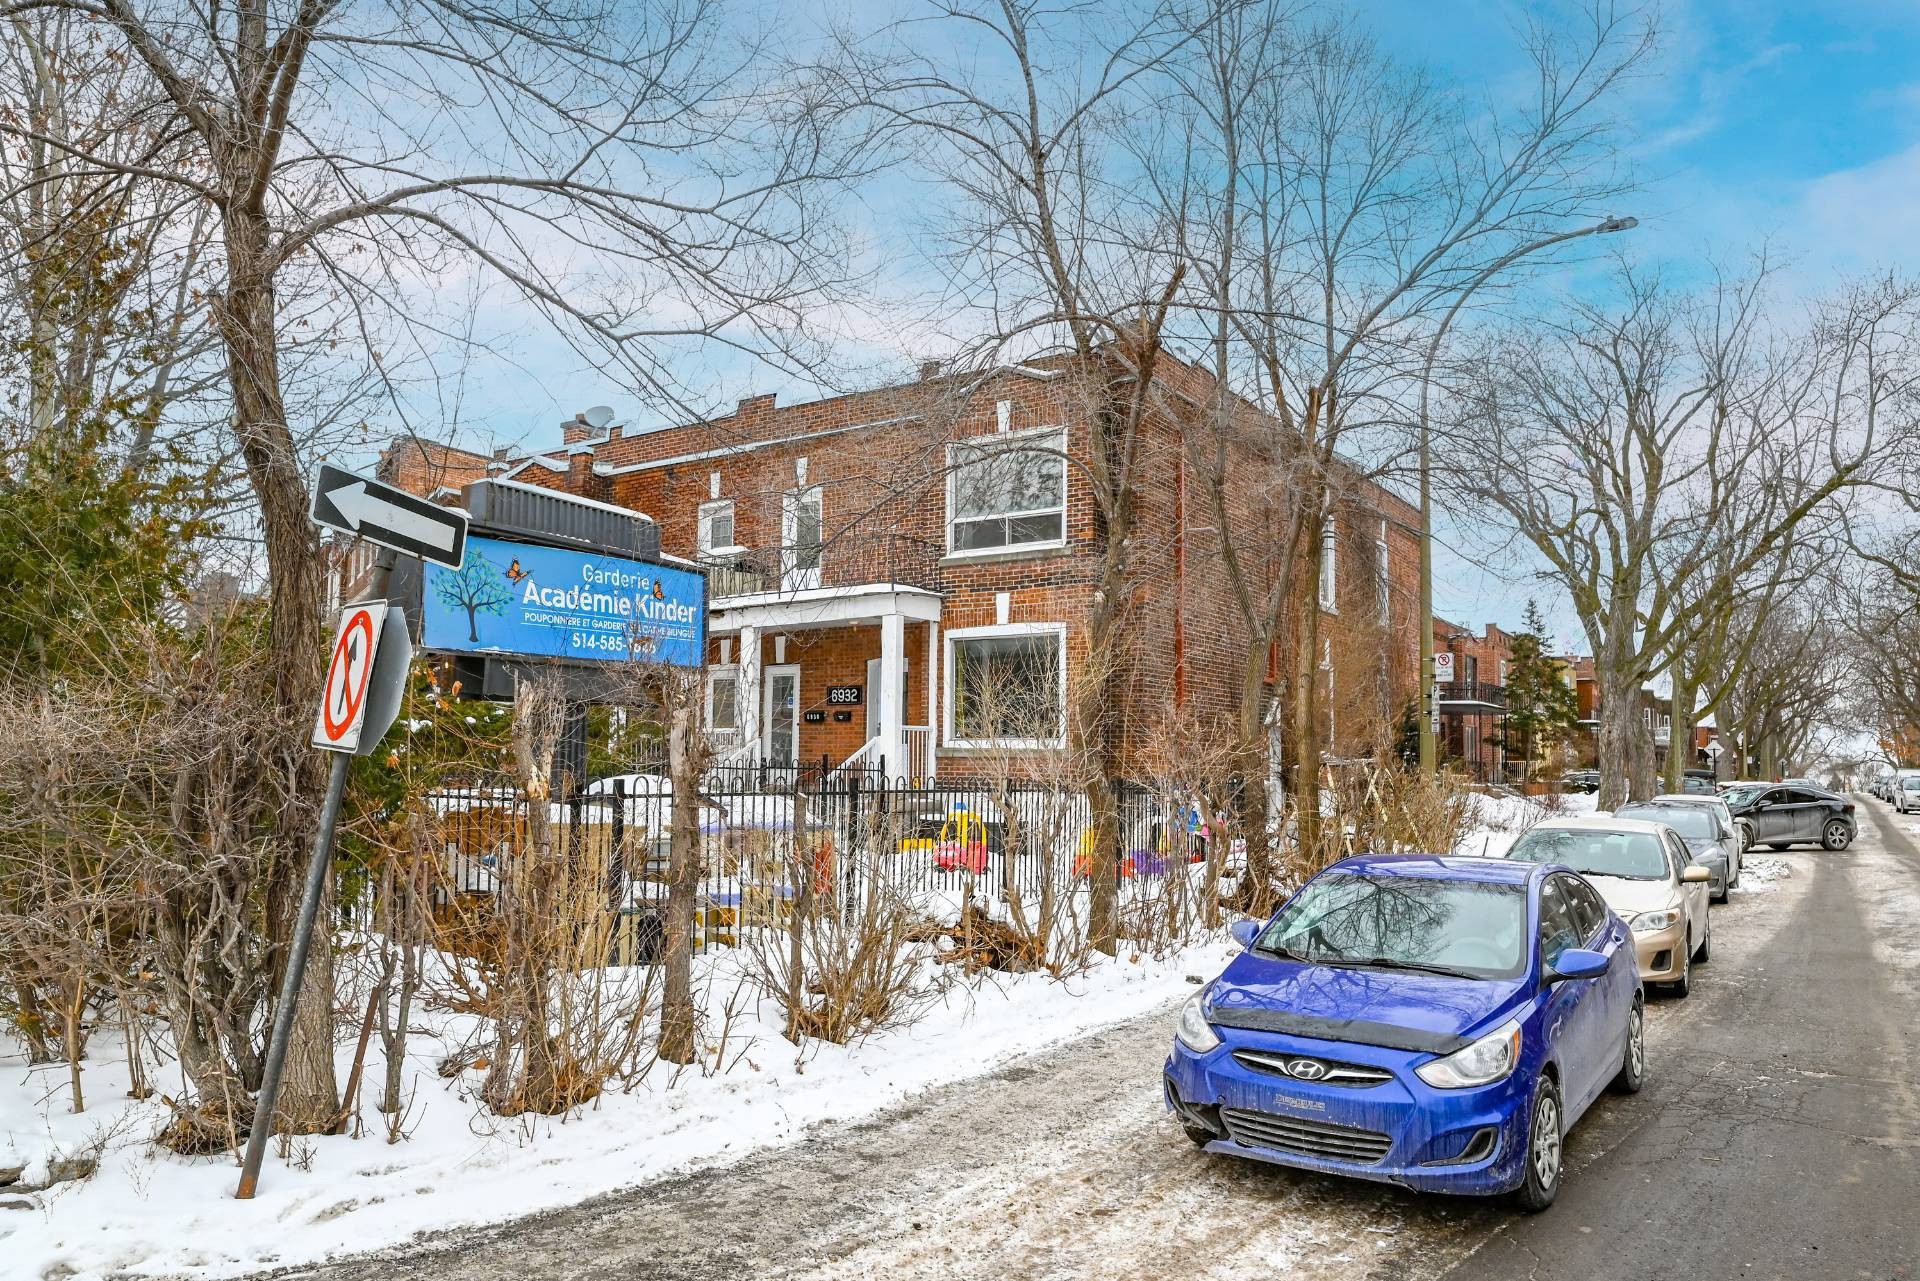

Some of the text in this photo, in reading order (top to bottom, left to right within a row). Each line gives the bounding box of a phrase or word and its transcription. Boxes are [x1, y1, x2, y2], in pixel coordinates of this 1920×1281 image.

[582, 563, 650, 591] Garderie
[522, 579, 697, 624] Académie Kinder
[582, 618, 590, 627] ET
[591, 619, 626, 631] GARDERIE
[831, 688, 858, 702] 6932
